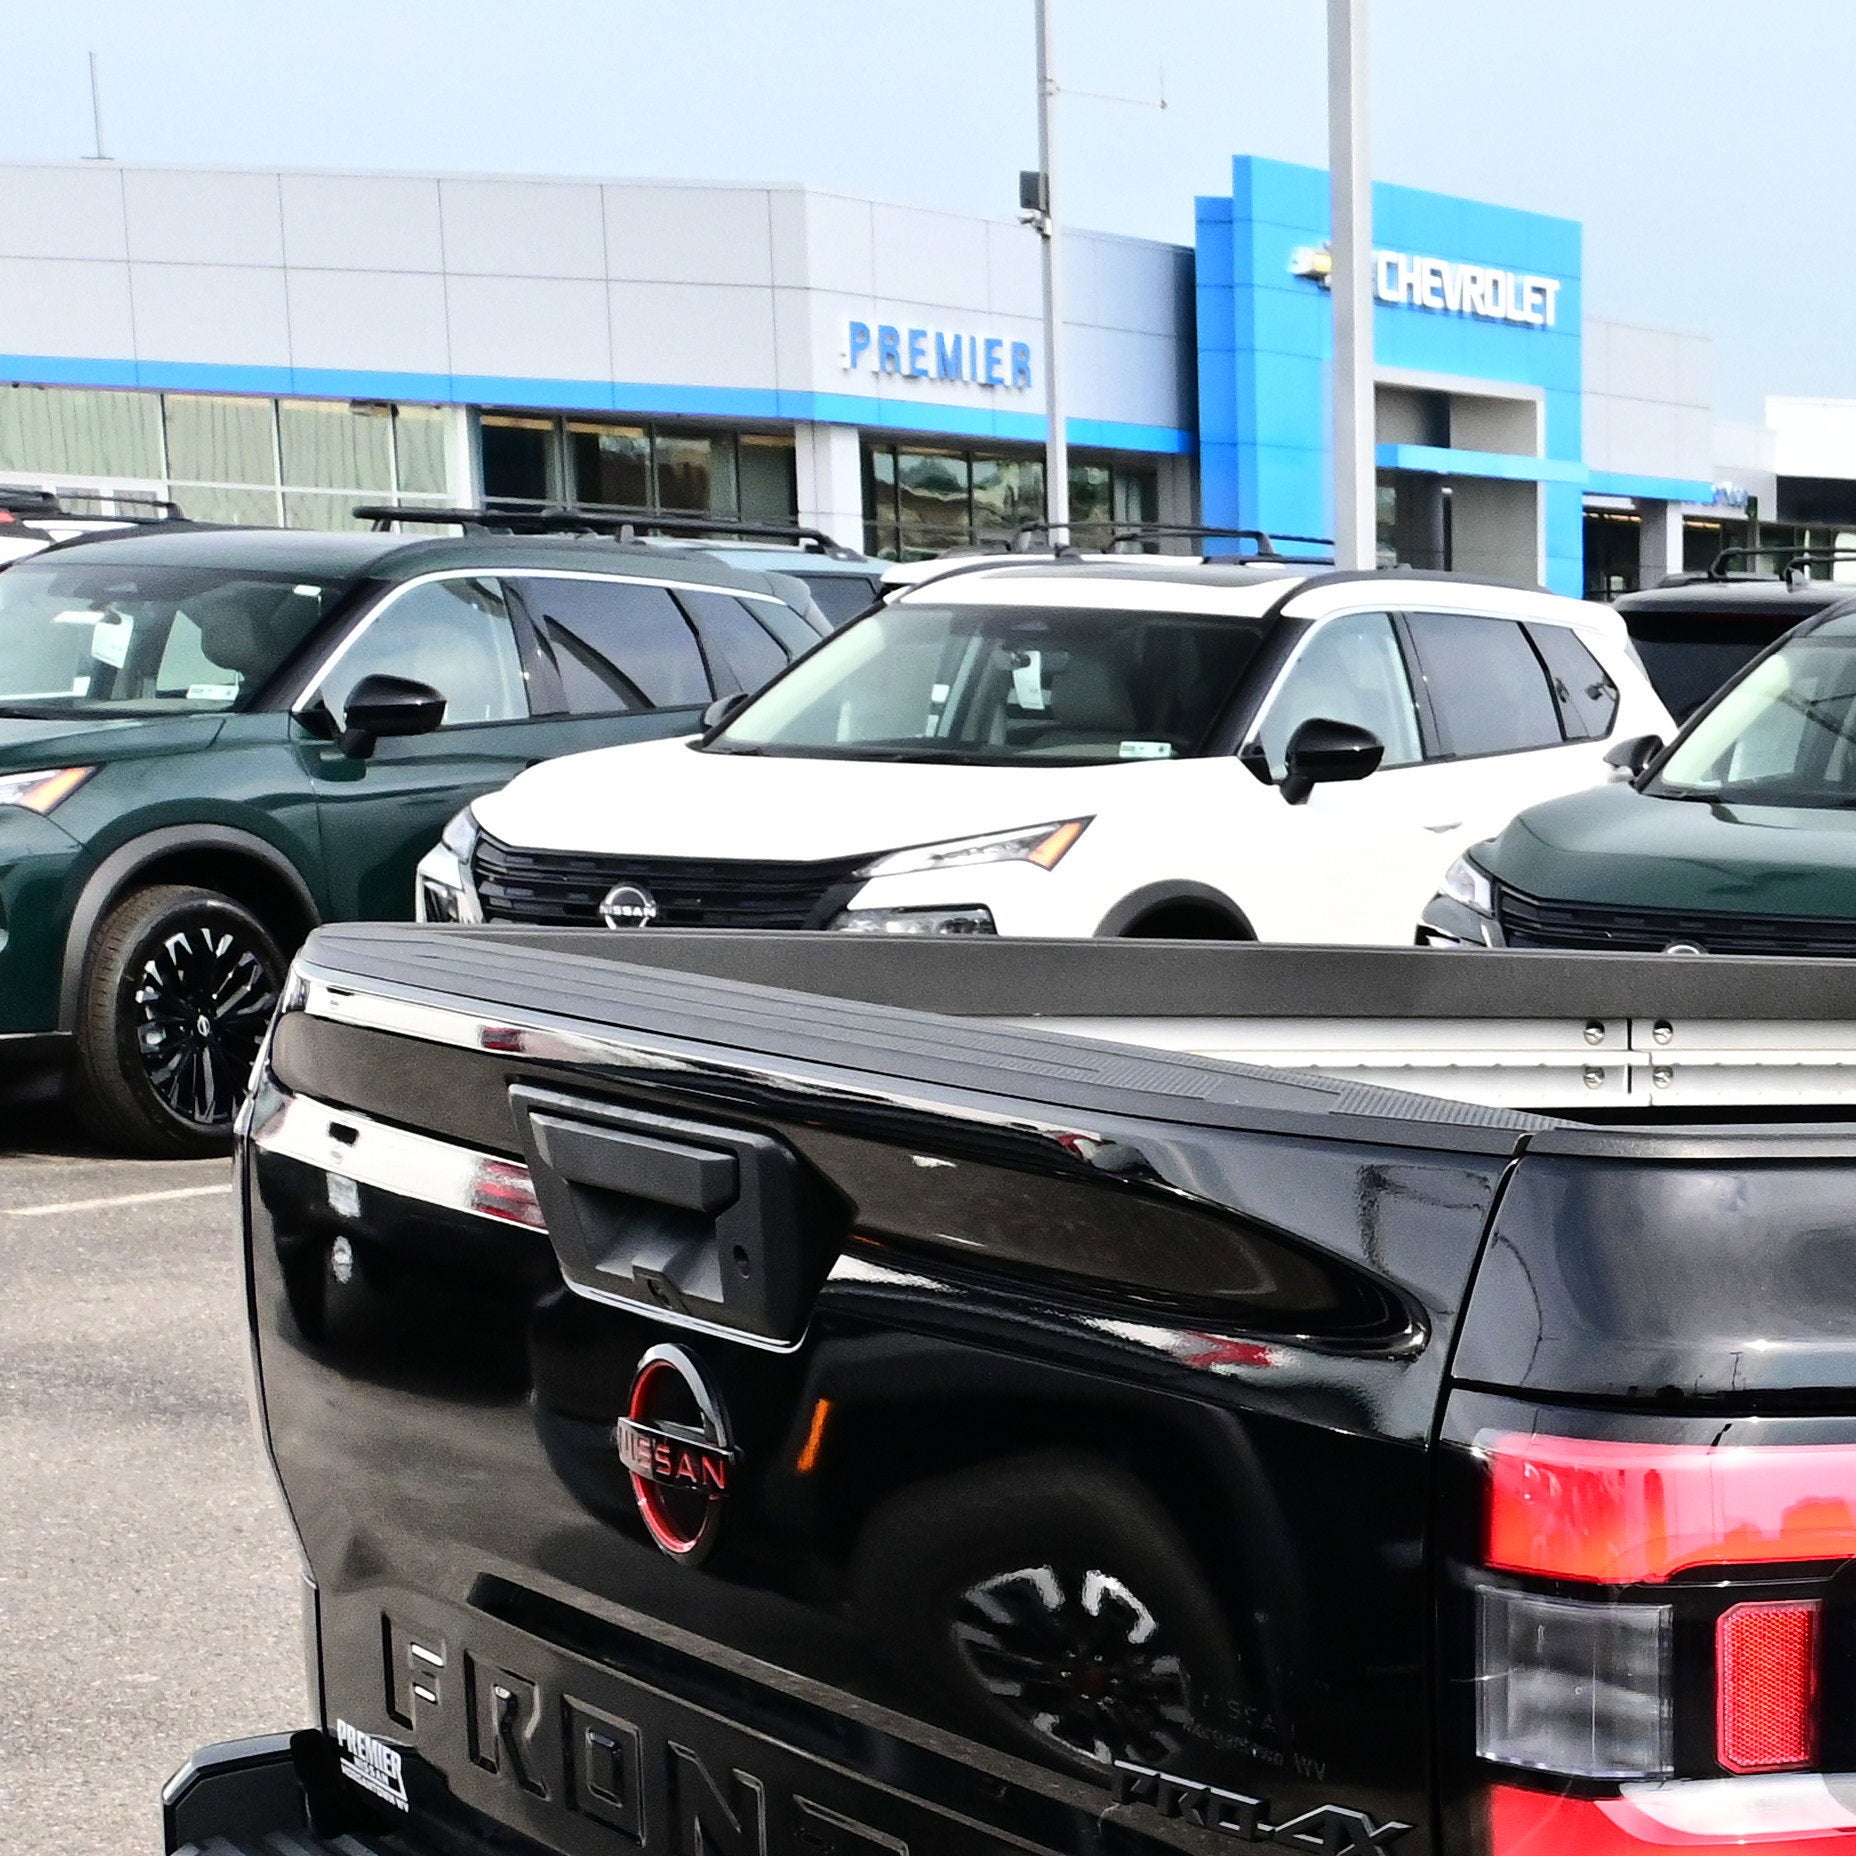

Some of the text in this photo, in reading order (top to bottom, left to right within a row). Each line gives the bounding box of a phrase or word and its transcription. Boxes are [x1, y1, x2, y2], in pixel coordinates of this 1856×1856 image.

[1376, 250, 1560, 326] CHEVROLET
[848, 320, 1033, 389] PREMIER
[599, 904, 657, 918] NISSAN
[616, 1424, 726, 1491] NISSAN
[336, 1718, 402, 1780] PREMIER
